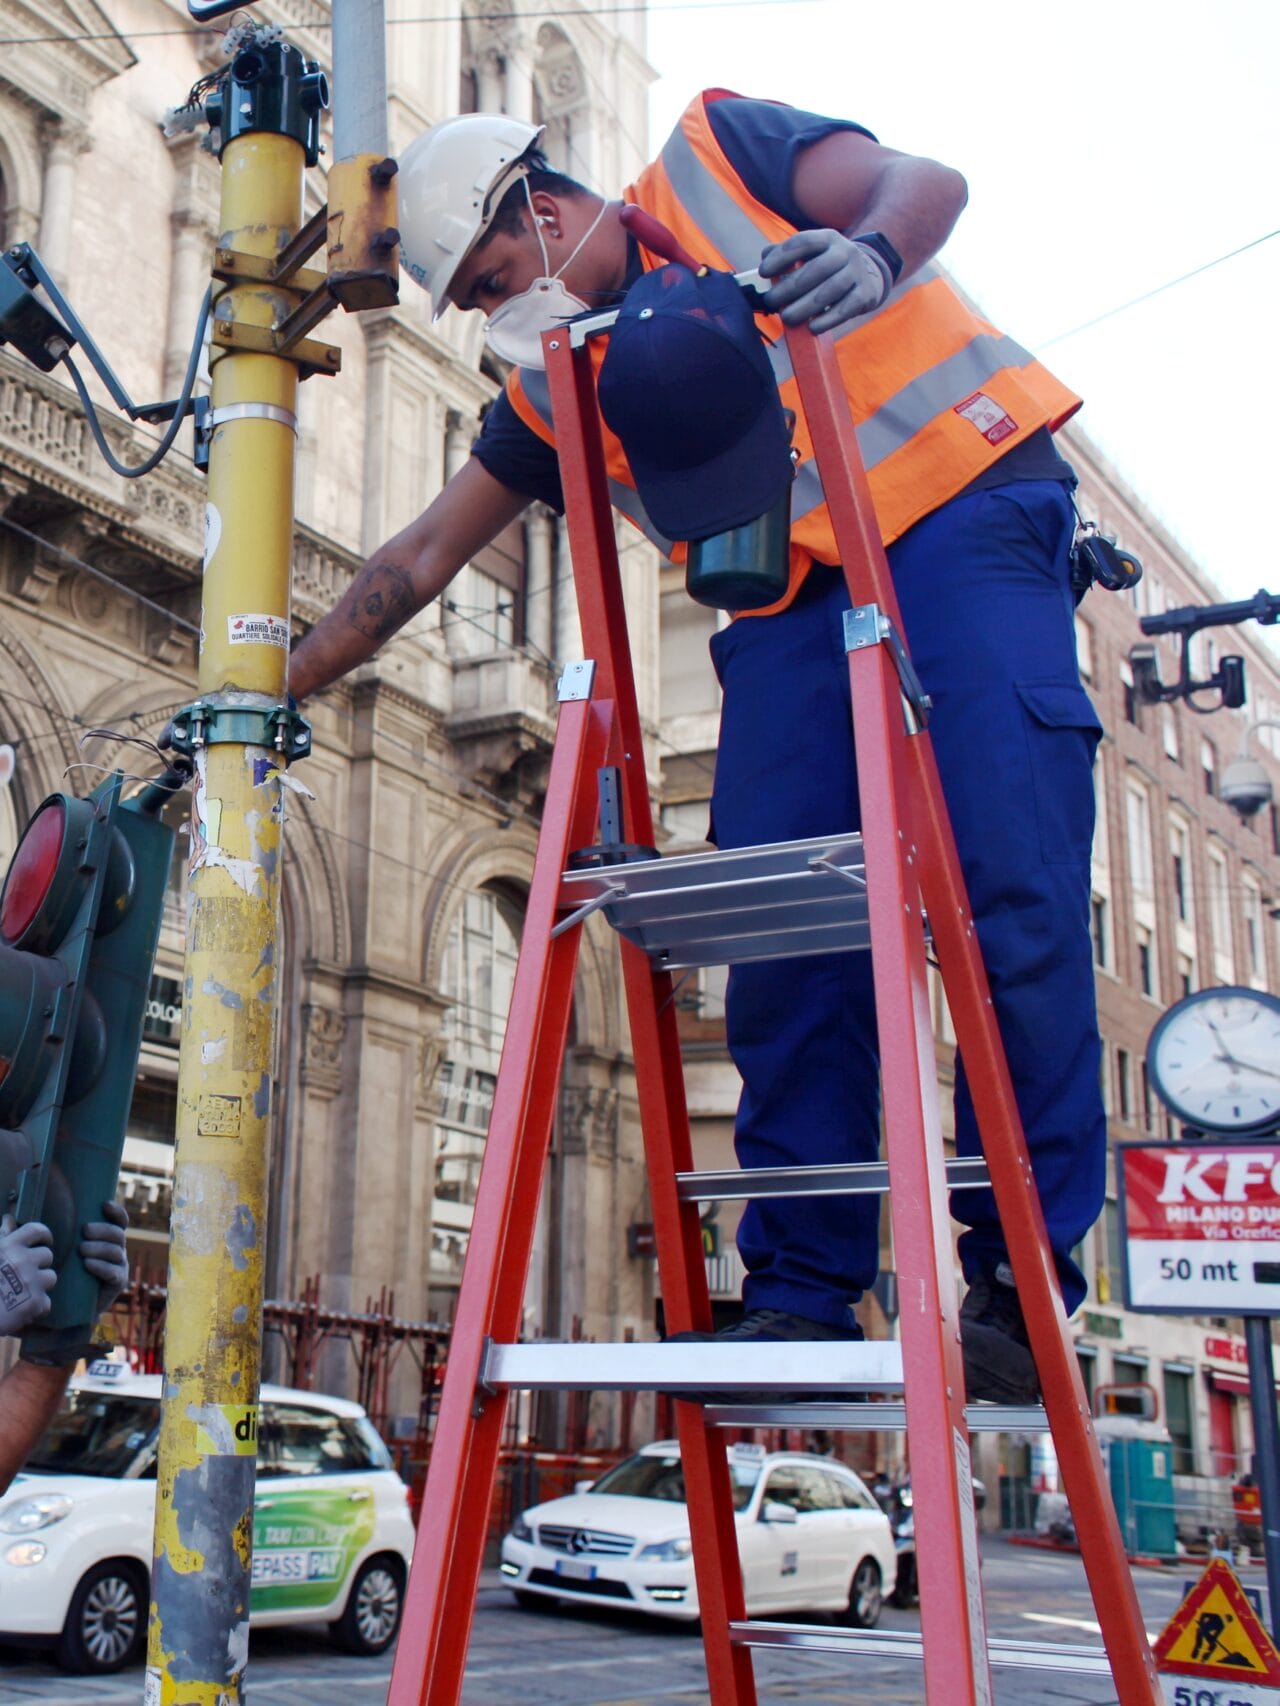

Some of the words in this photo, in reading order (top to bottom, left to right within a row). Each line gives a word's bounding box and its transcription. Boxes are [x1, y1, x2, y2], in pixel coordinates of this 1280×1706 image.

[1165, 1206, 1245, 1223] MILANO
[1202, 1226, 1229, 1239] Via
[1160, 1258, 1191, 1281] 50
[1202, 1259, 1238, 1282] mt
